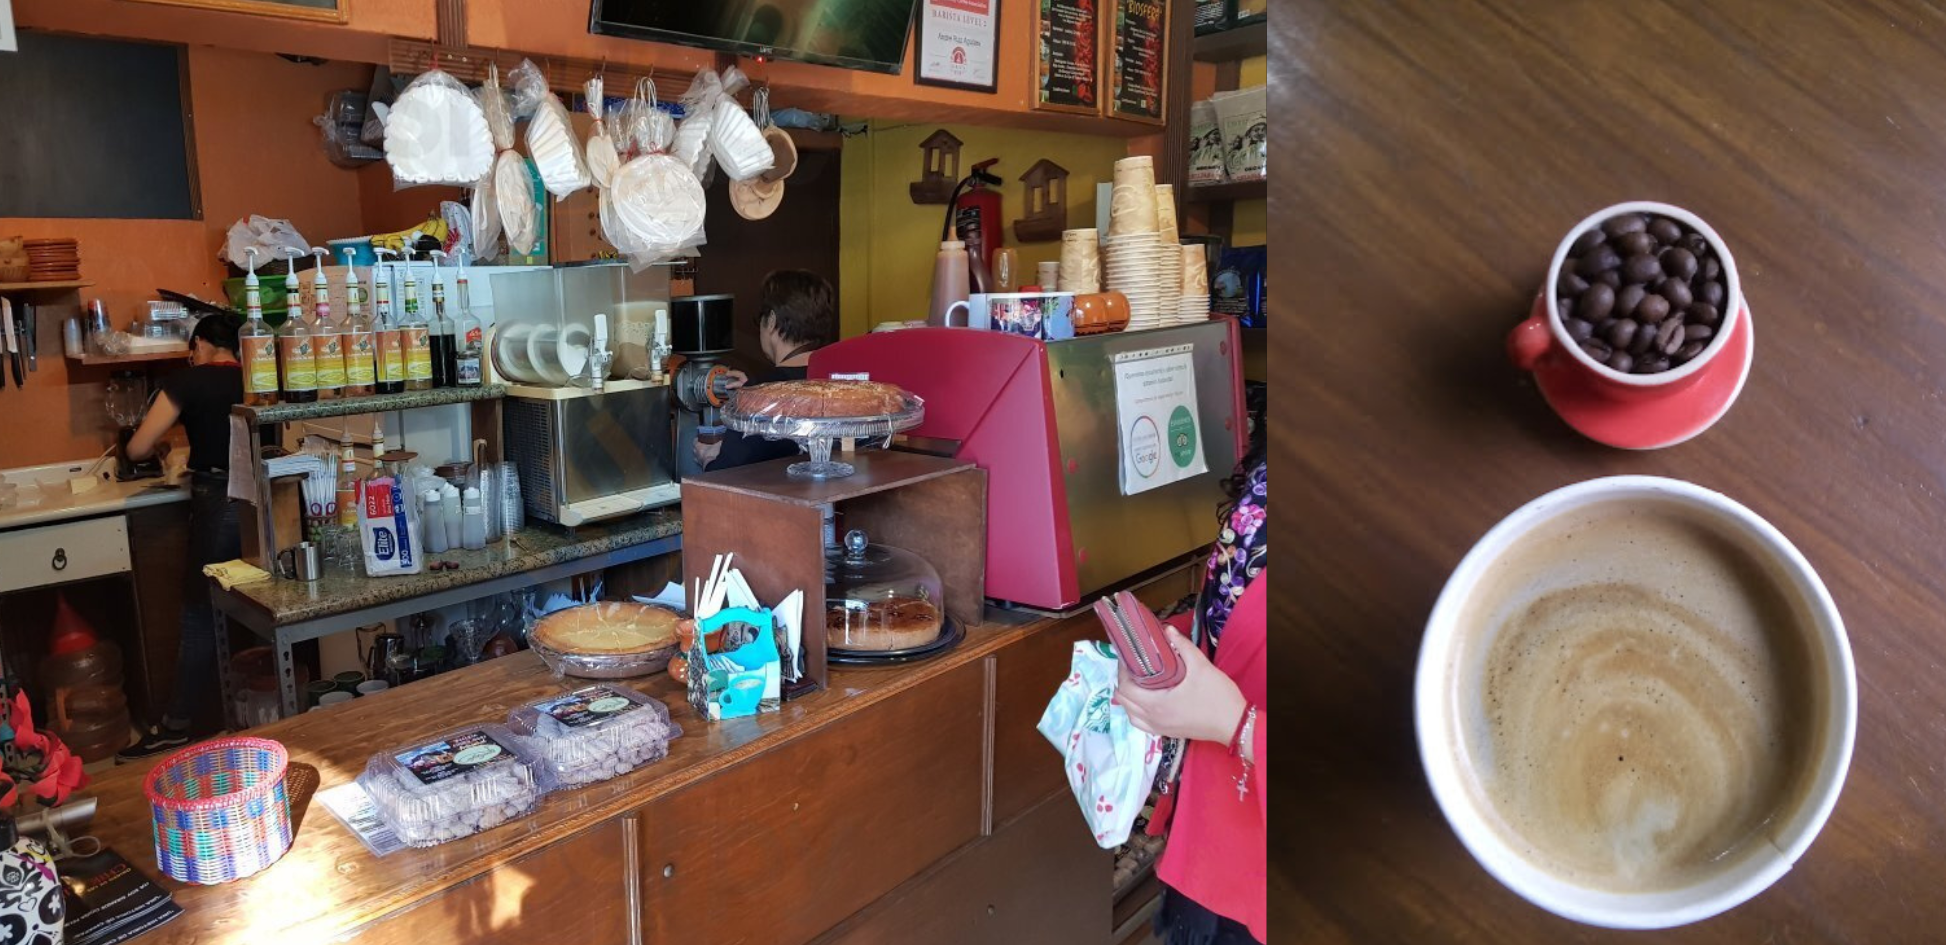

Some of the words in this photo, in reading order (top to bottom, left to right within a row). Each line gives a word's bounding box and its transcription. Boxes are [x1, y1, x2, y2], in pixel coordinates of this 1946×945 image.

[932, 9, 961, 22] BARISTA
[1135, 451, 1157, 464] Google
[378, 531, 389, 555] Elite
